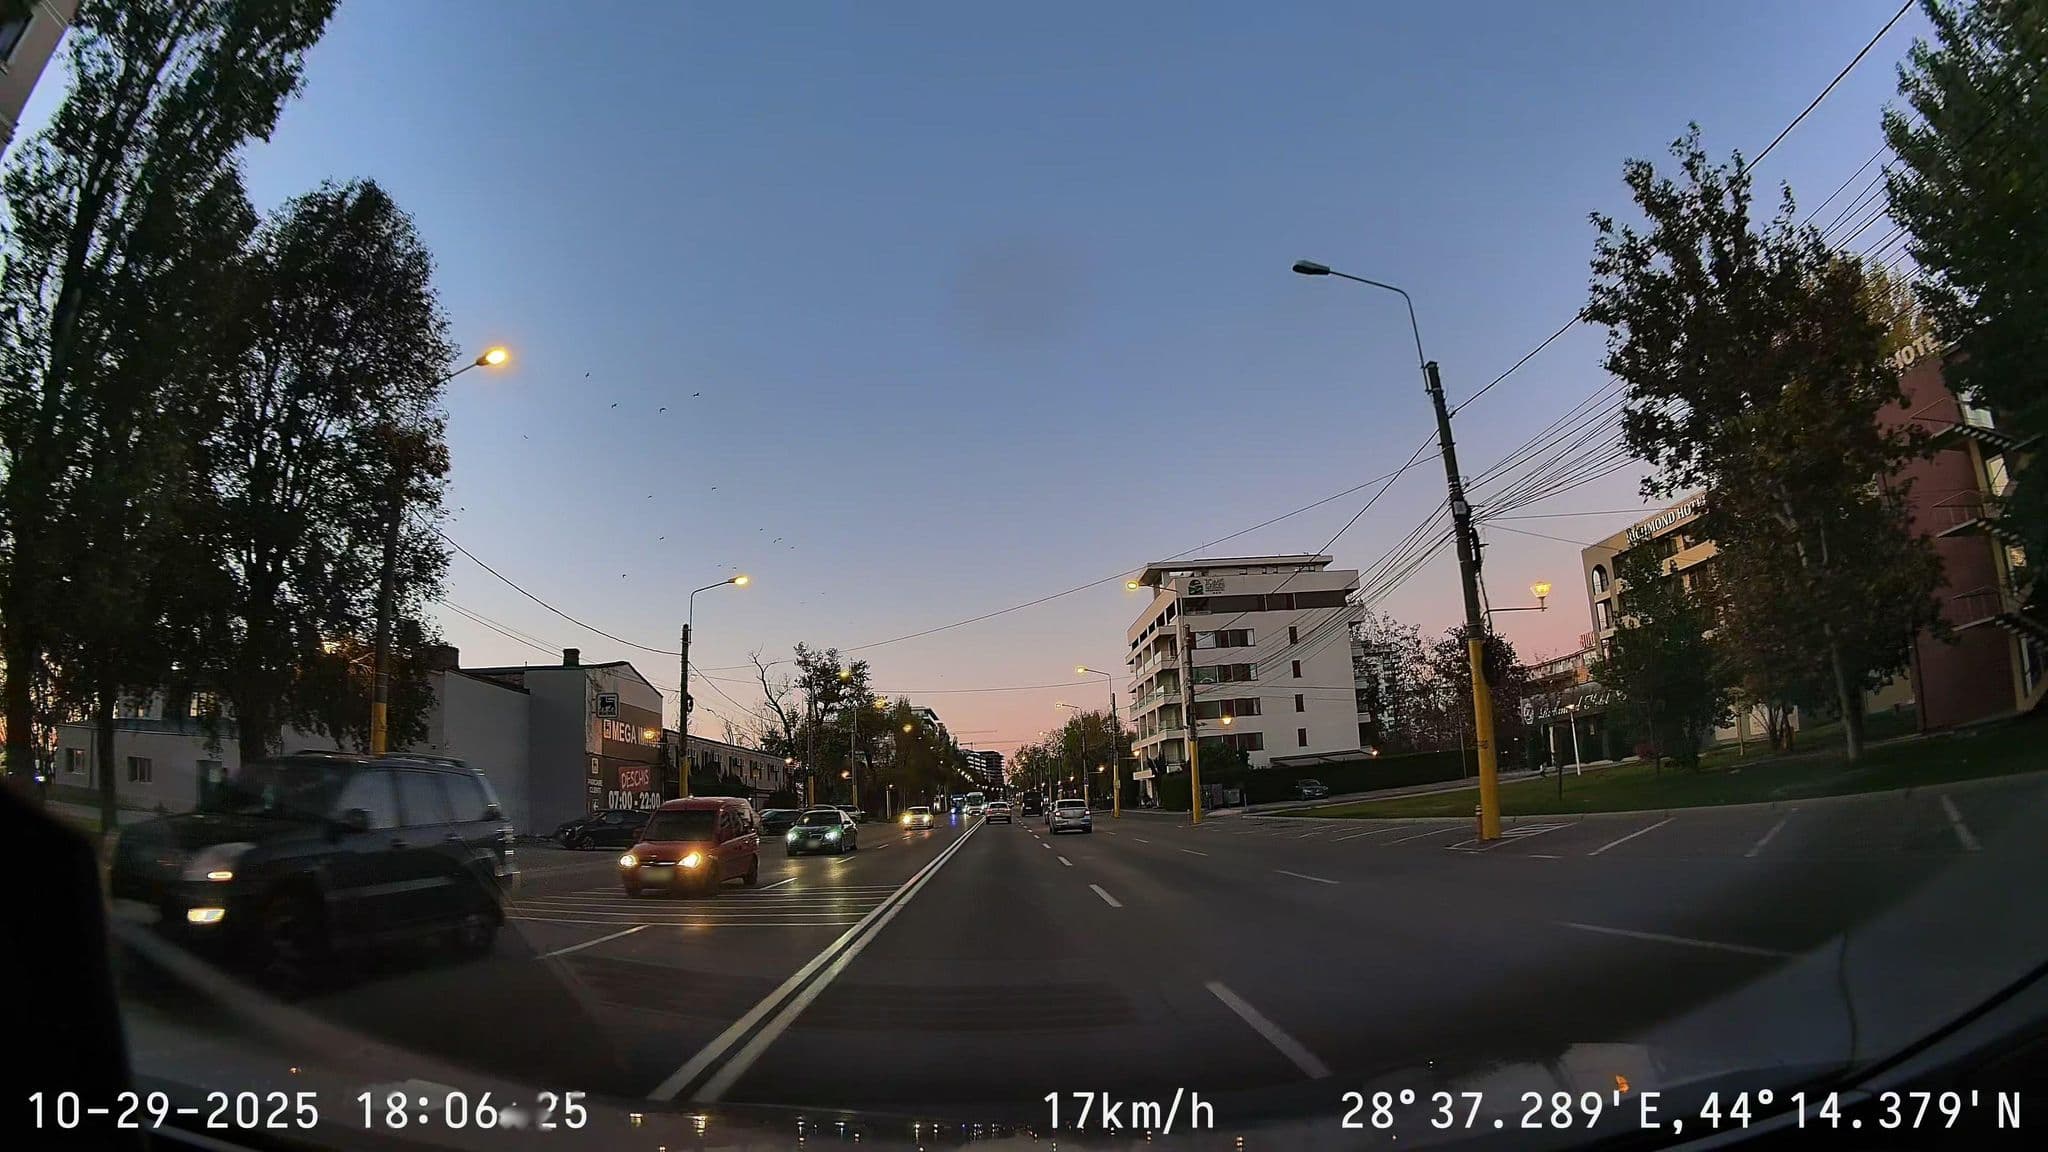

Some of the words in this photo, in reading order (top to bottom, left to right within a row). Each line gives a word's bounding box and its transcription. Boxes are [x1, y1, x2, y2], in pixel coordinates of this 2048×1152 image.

[612, 720, 637, 744] MEGA
[621, 769, 649, 790] DESCHIS
[608, 790, 633, 810] 07:00
[639, 791, 661, 811] 22:00
